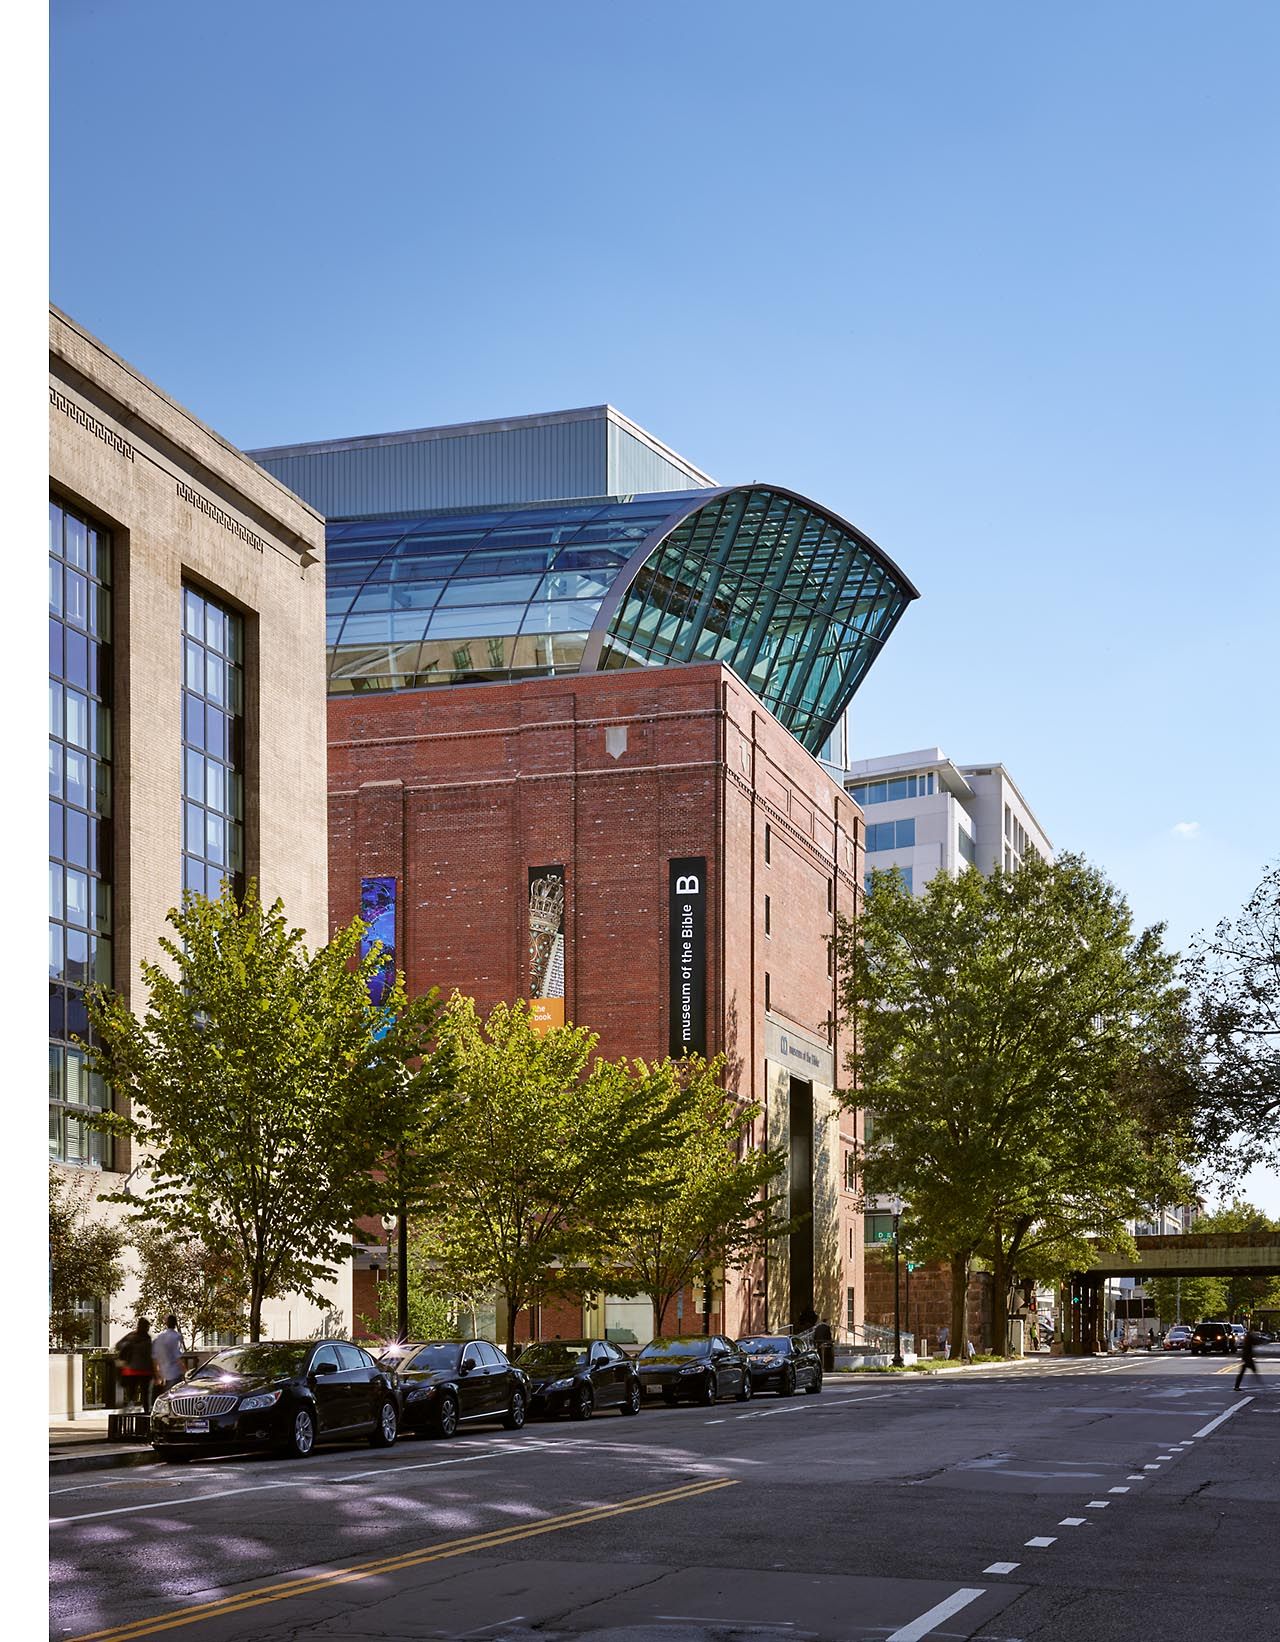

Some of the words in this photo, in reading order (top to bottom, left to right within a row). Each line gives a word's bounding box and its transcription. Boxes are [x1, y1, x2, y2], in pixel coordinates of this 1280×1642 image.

[676, 875, 700, 895] B
[682, 904, 693, 938] Bible
[681, 942, 692, 963] the
[681, 966, 692, 979] of
[682, 982, 691, 1041] museum
